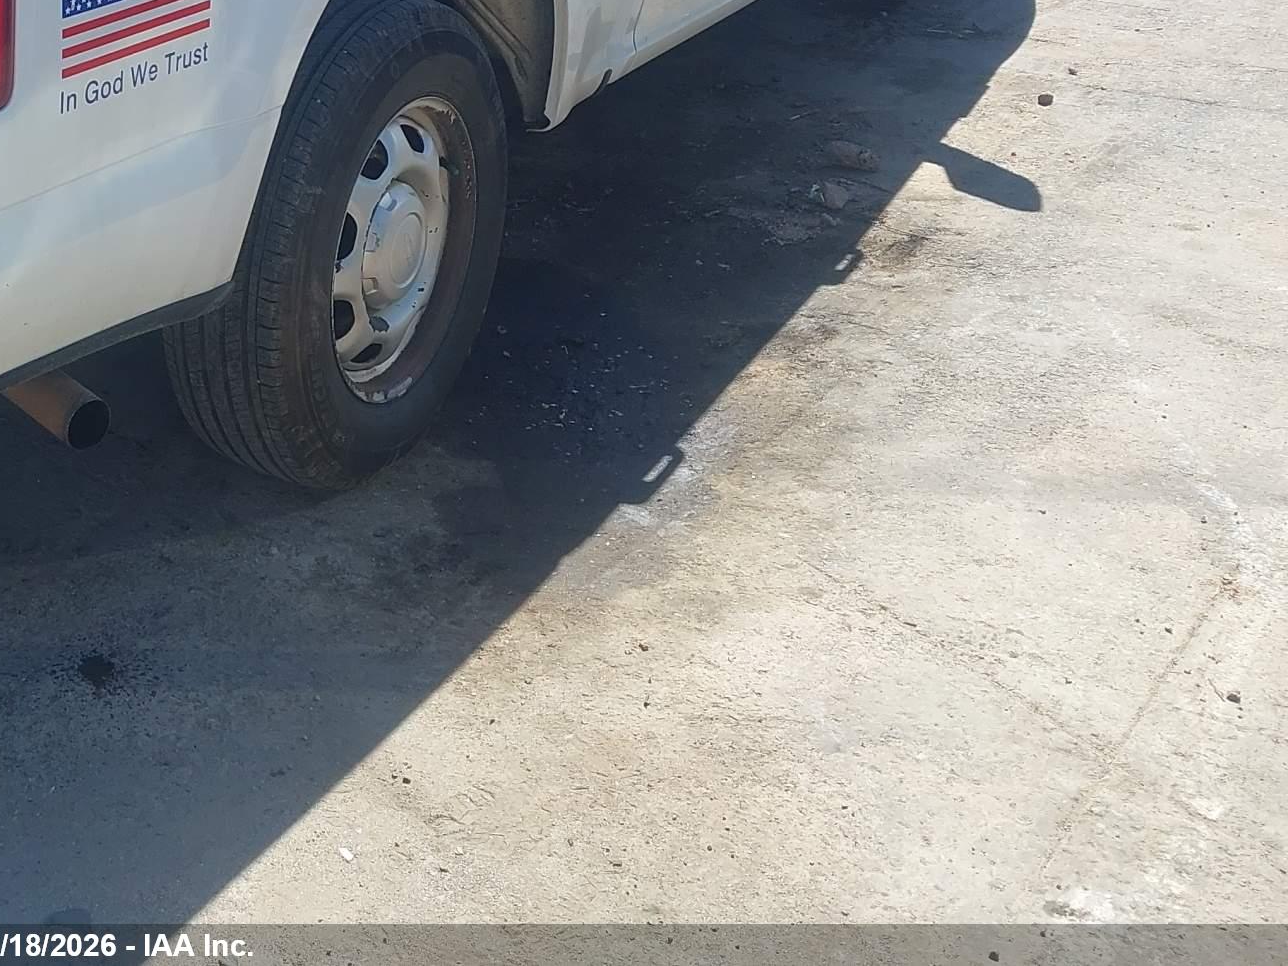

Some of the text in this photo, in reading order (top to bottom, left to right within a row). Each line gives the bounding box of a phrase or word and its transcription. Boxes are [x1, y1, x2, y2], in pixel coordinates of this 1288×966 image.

[60, 42, 208, 114] In God We Trust
